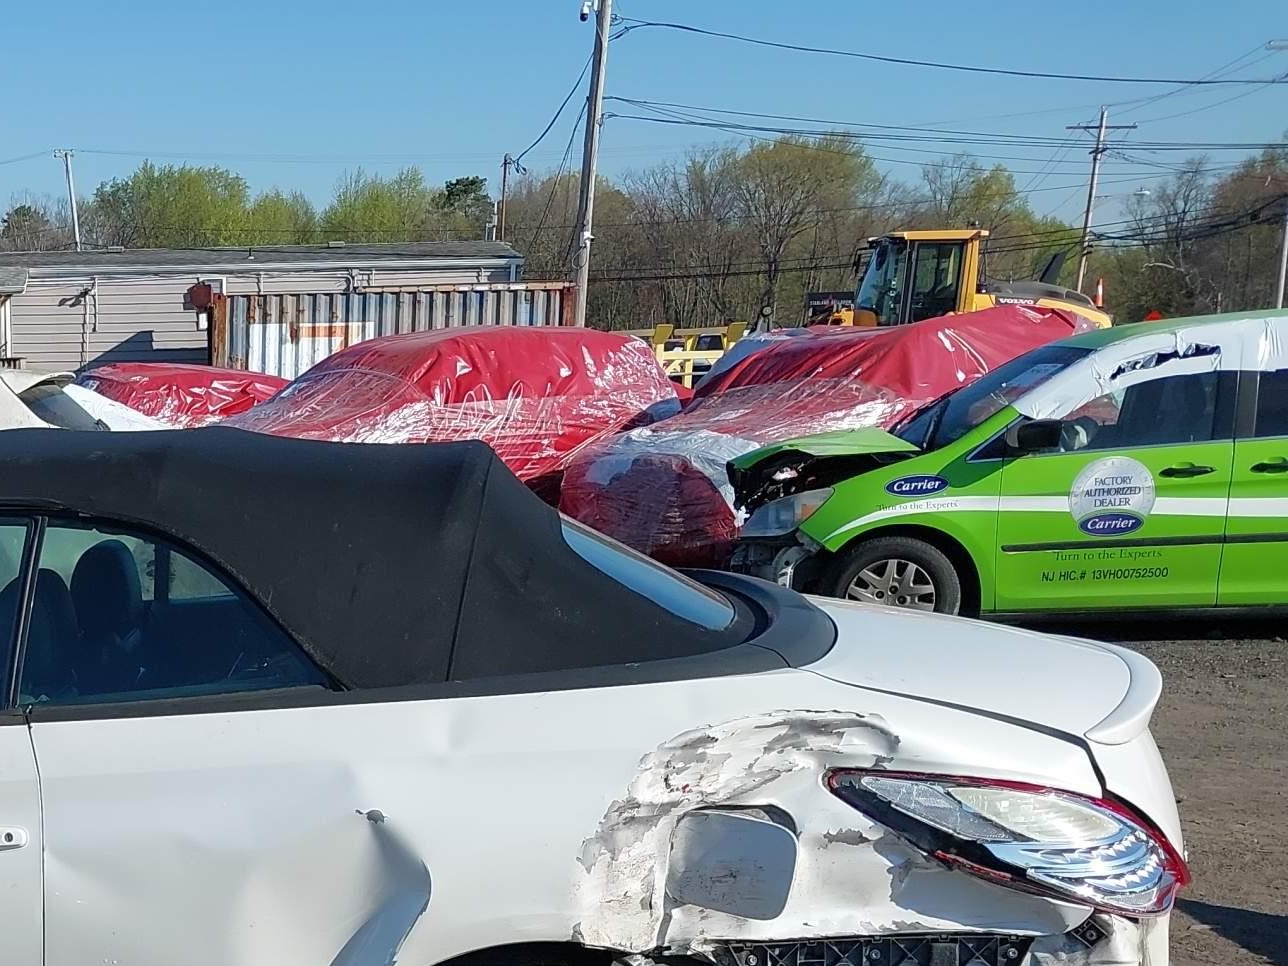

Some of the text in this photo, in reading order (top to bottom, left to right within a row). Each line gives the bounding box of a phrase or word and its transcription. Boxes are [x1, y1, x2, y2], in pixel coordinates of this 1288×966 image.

[893, 479, 942, 492] Carrier
[1094, 476, 1134, 486] FACTORY
[1084, 486, 1141, 498] AUTHORIZED
[925, 501, 958, 510] Experts
[1094, 497, 1131, 508] DEALER
[1087, 517, 1136, 530] Carrier
[1054, 549, 1163, 561] Turn to the Experts
[1041, 567, 1169, 582] NJ HIC.# 13VH00752500
